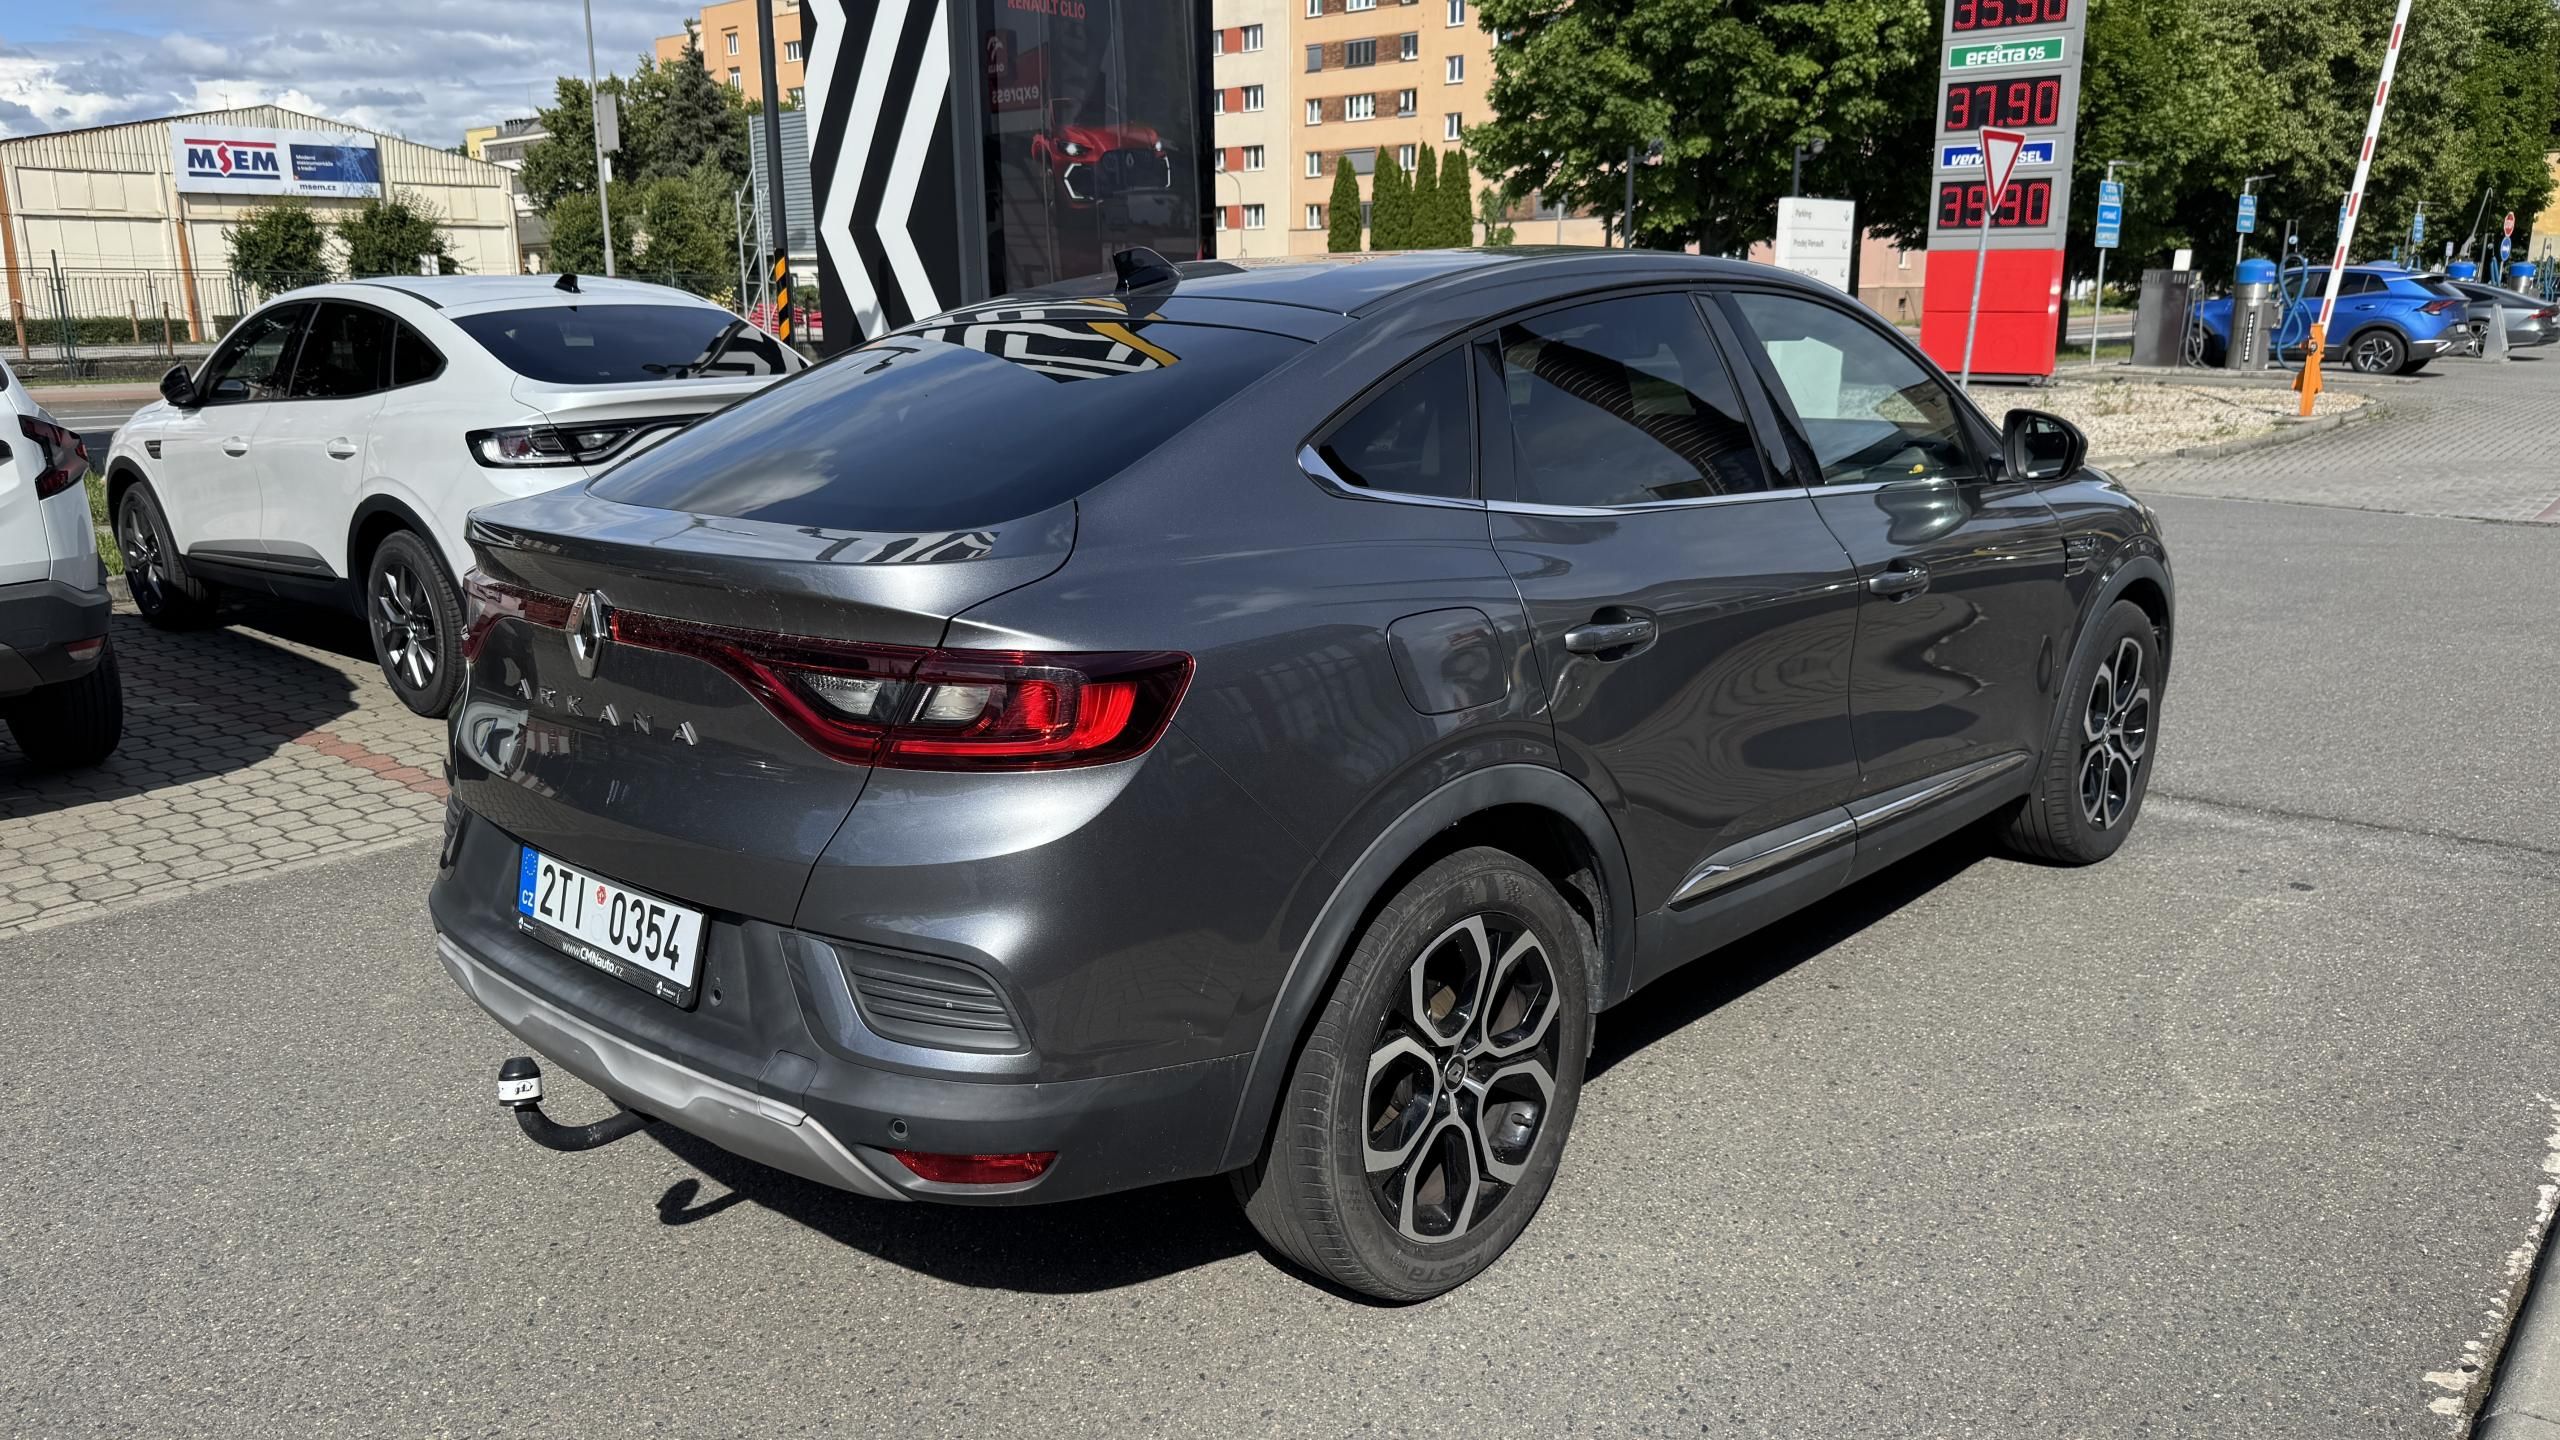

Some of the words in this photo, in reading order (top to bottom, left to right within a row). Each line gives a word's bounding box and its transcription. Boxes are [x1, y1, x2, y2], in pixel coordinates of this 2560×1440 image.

[1008, 0, 1058, 15] RENAULT
[1060, 1, 1086, 19] CLIO
[2028, 46, 2046, 60] 95
[1947, 80, 2059, 129] 37.90
[188, 145, 280, 174] MSEM
[1951, 153, 1984, 166] verv
[299, 183, 337, 191] msem.cz
[1939, 182, 2050, 227] 39.90
[516, 677, 700, 747] ARKANA
[522, 889, 534, 907] CZ
[539, 864, 585, 930] 2TI
[609, 892, 681, 972] 0354
[562, 942, 624, 978] www.CMNauto.cz
